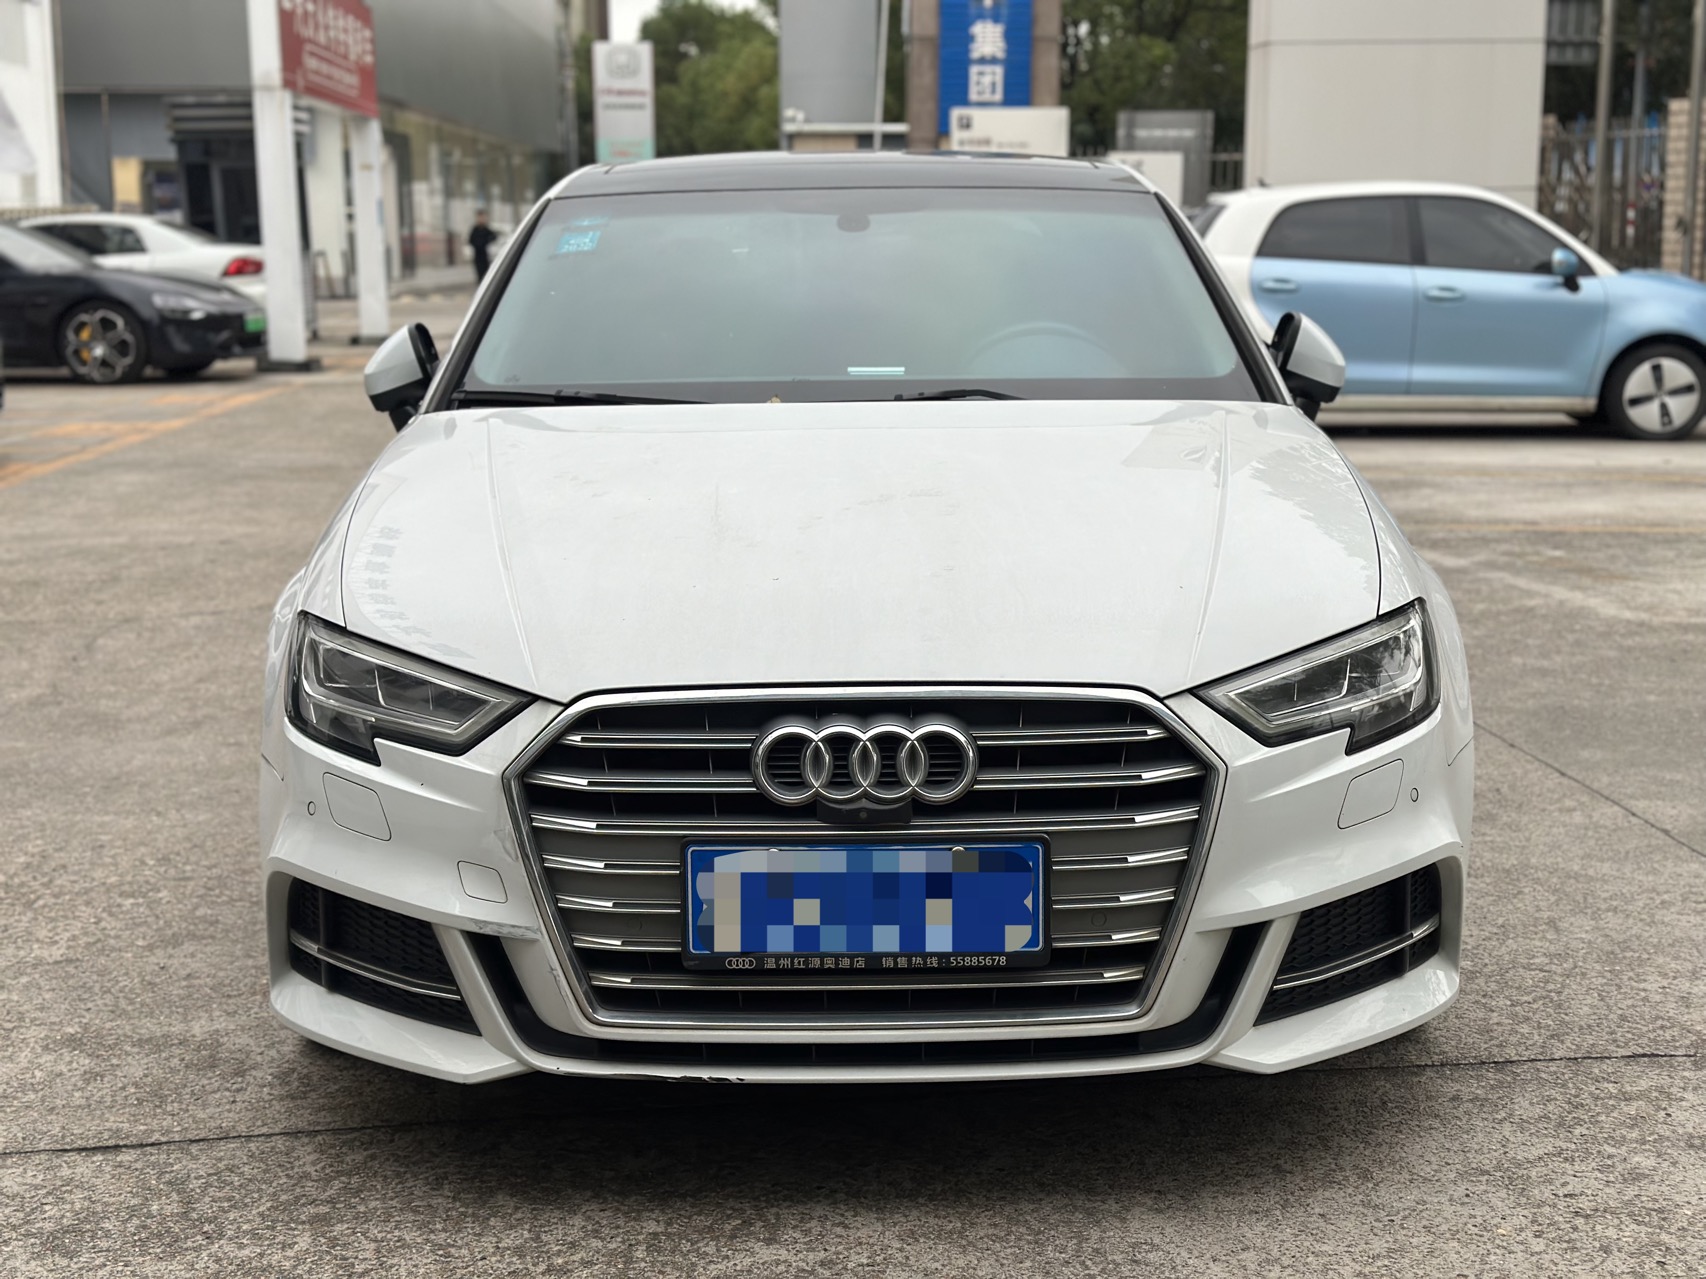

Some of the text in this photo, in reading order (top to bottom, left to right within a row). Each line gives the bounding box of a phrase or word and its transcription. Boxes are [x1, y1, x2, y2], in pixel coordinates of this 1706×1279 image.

[968, 0, 1006, 103] 集团
[764, 957, 866, 969] 温州红源奥迪店
